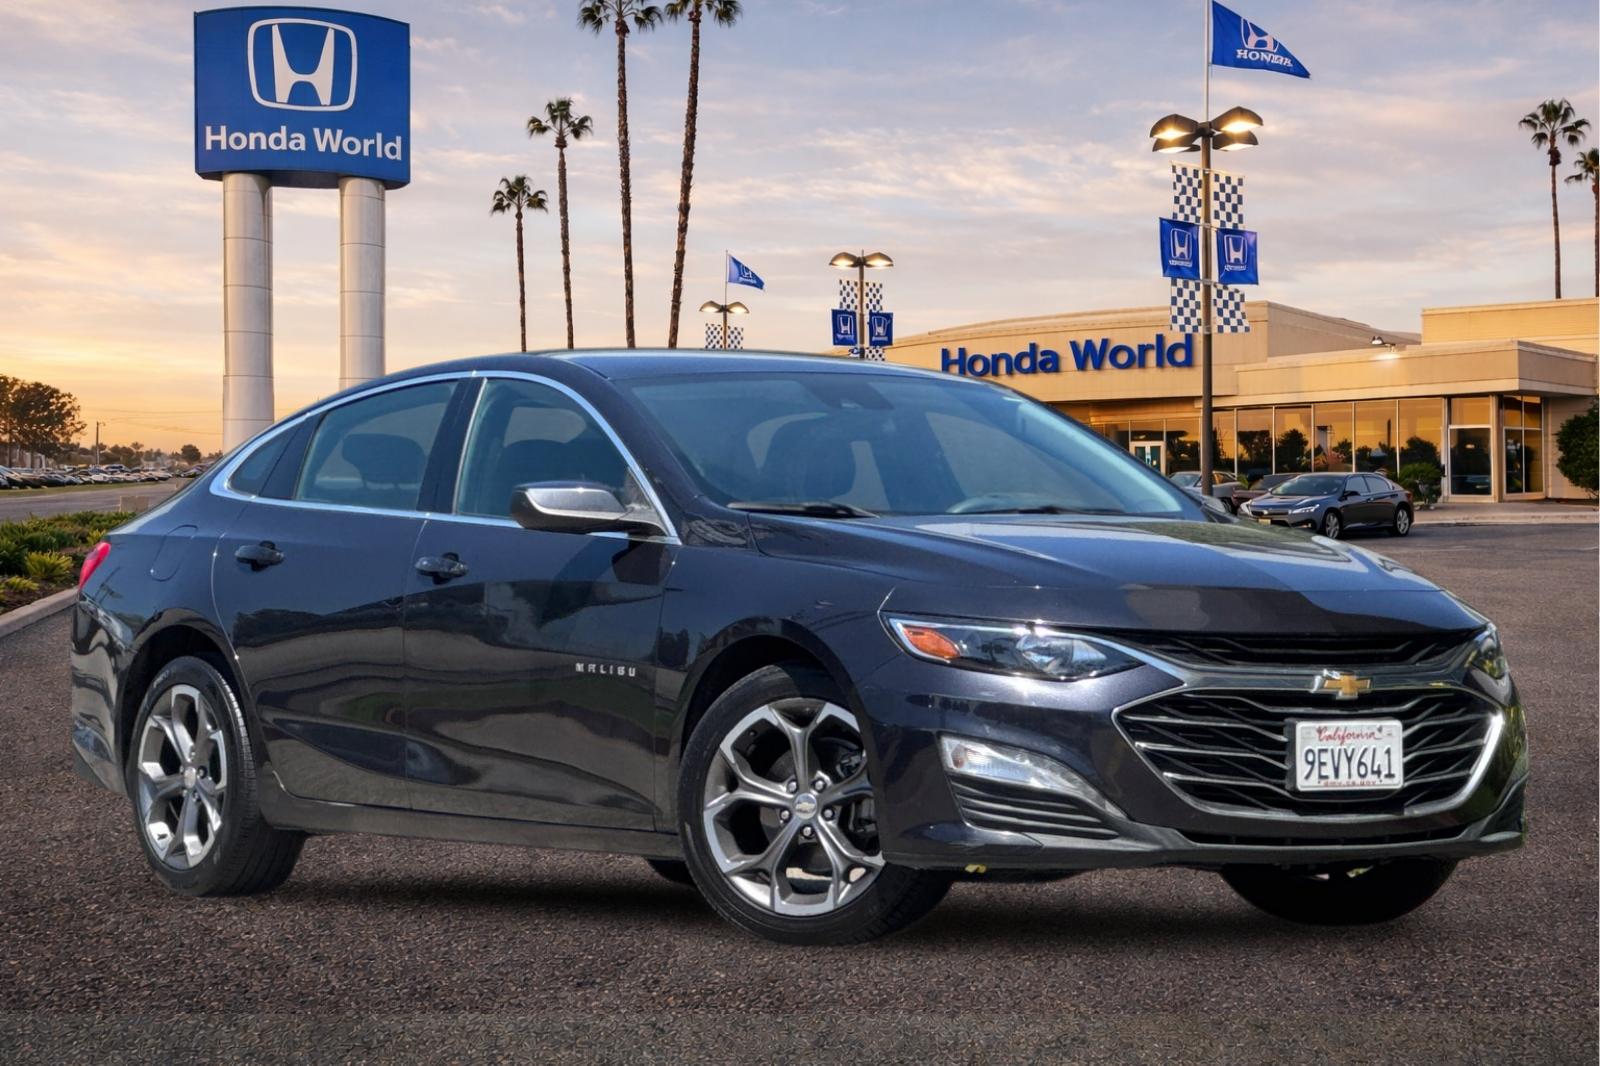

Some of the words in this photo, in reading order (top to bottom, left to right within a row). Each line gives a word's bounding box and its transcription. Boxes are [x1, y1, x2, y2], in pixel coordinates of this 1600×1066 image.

[205, 125, 306, 151] Honda
[313, 127, 402, 161] World
[941, 342, 1062, 378] Honda
[1069, 332, 1195, 372] World
[575, 662, 637, 677] MALIBU
[1317, 725, 1382, 745] California
[1303, 746, 1396, 781] 9EVY641
